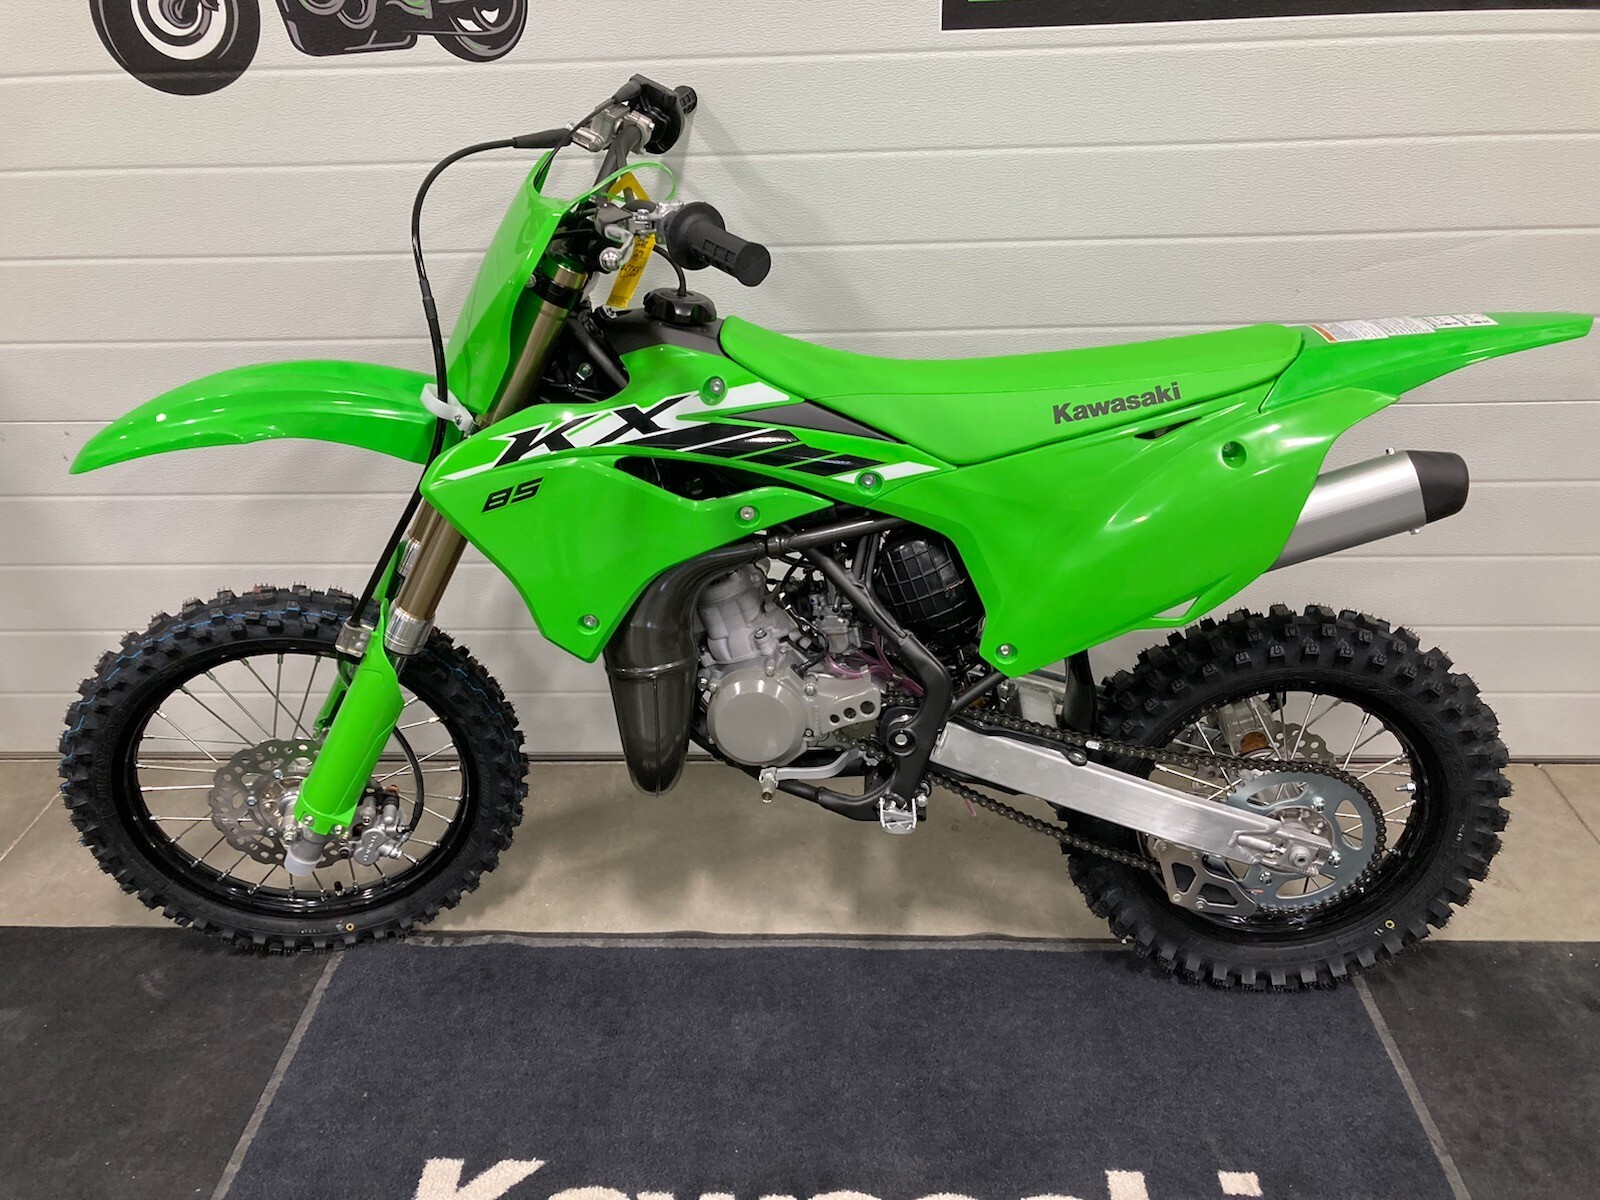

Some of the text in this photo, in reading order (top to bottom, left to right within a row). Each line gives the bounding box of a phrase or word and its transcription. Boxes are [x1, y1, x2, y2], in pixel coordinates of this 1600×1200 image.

[1052, 381, 1182, 425] Kawasaki
[492, 394, 693, 468] KX
[481, 476, 544, 513] 85
